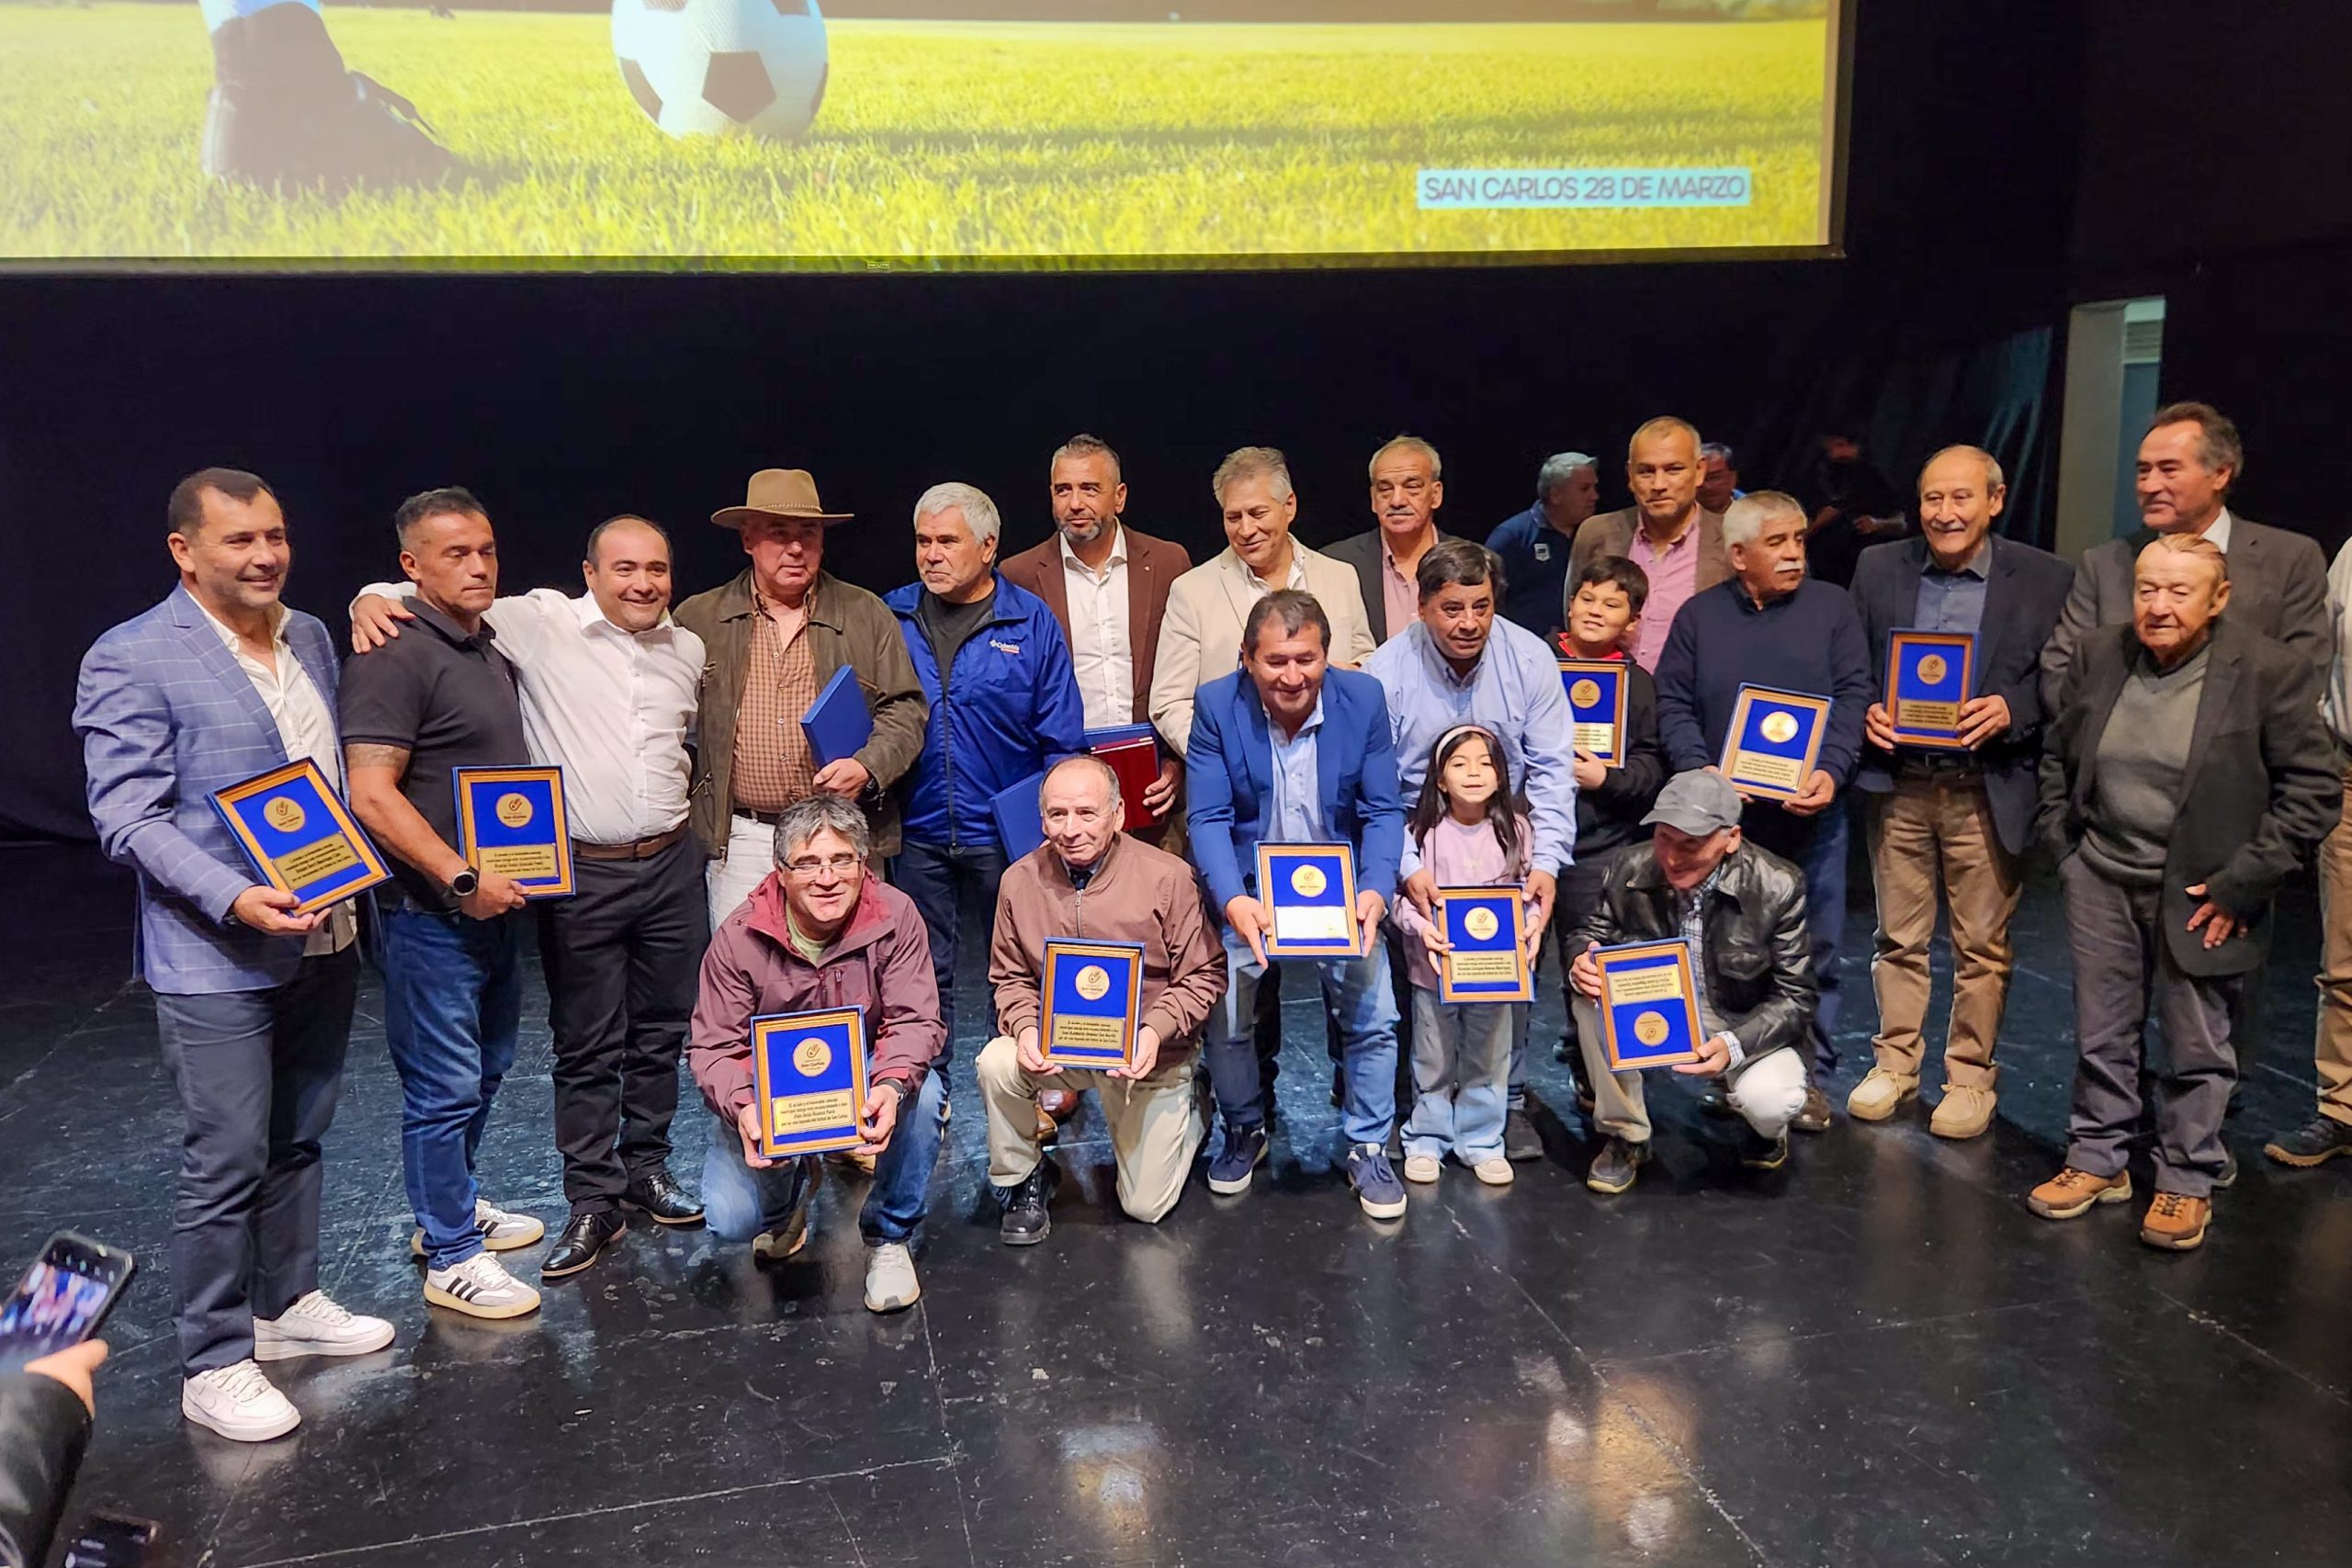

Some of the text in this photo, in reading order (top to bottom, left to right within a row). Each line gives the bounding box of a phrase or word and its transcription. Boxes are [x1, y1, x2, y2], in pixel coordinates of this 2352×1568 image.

[1425, 175, 1746, 200] SAN CARLOS 28 DE MARZO
